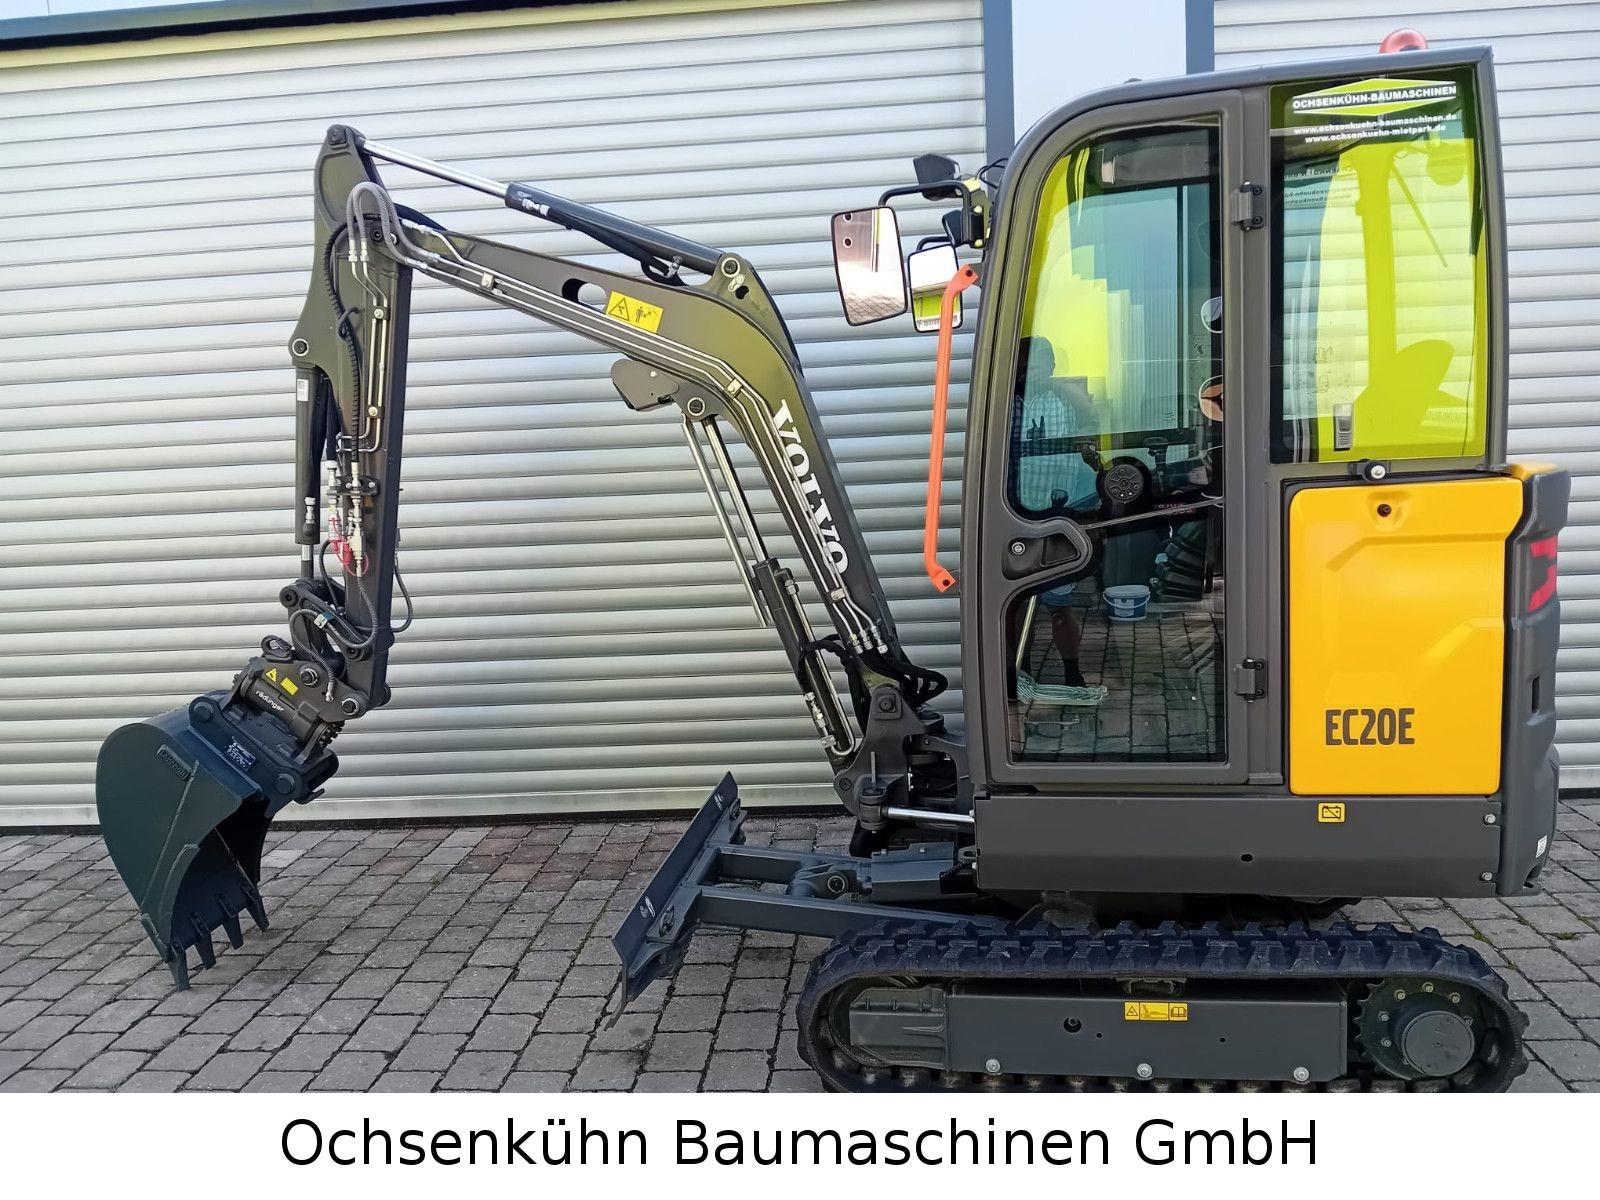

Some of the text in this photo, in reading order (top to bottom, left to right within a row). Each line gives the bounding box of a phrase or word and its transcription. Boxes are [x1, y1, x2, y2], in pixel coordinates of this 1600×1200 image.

[1292, 85, 1457, 109] OCHSENKÜHN-BAUMASCHINEN
[1294, 113, 1457, 135] www.ochsenkuehn-baumaschinen.de
[772, 399, 849, 574] VOLVO
[1325, 707, 1416, 745] EC20E
